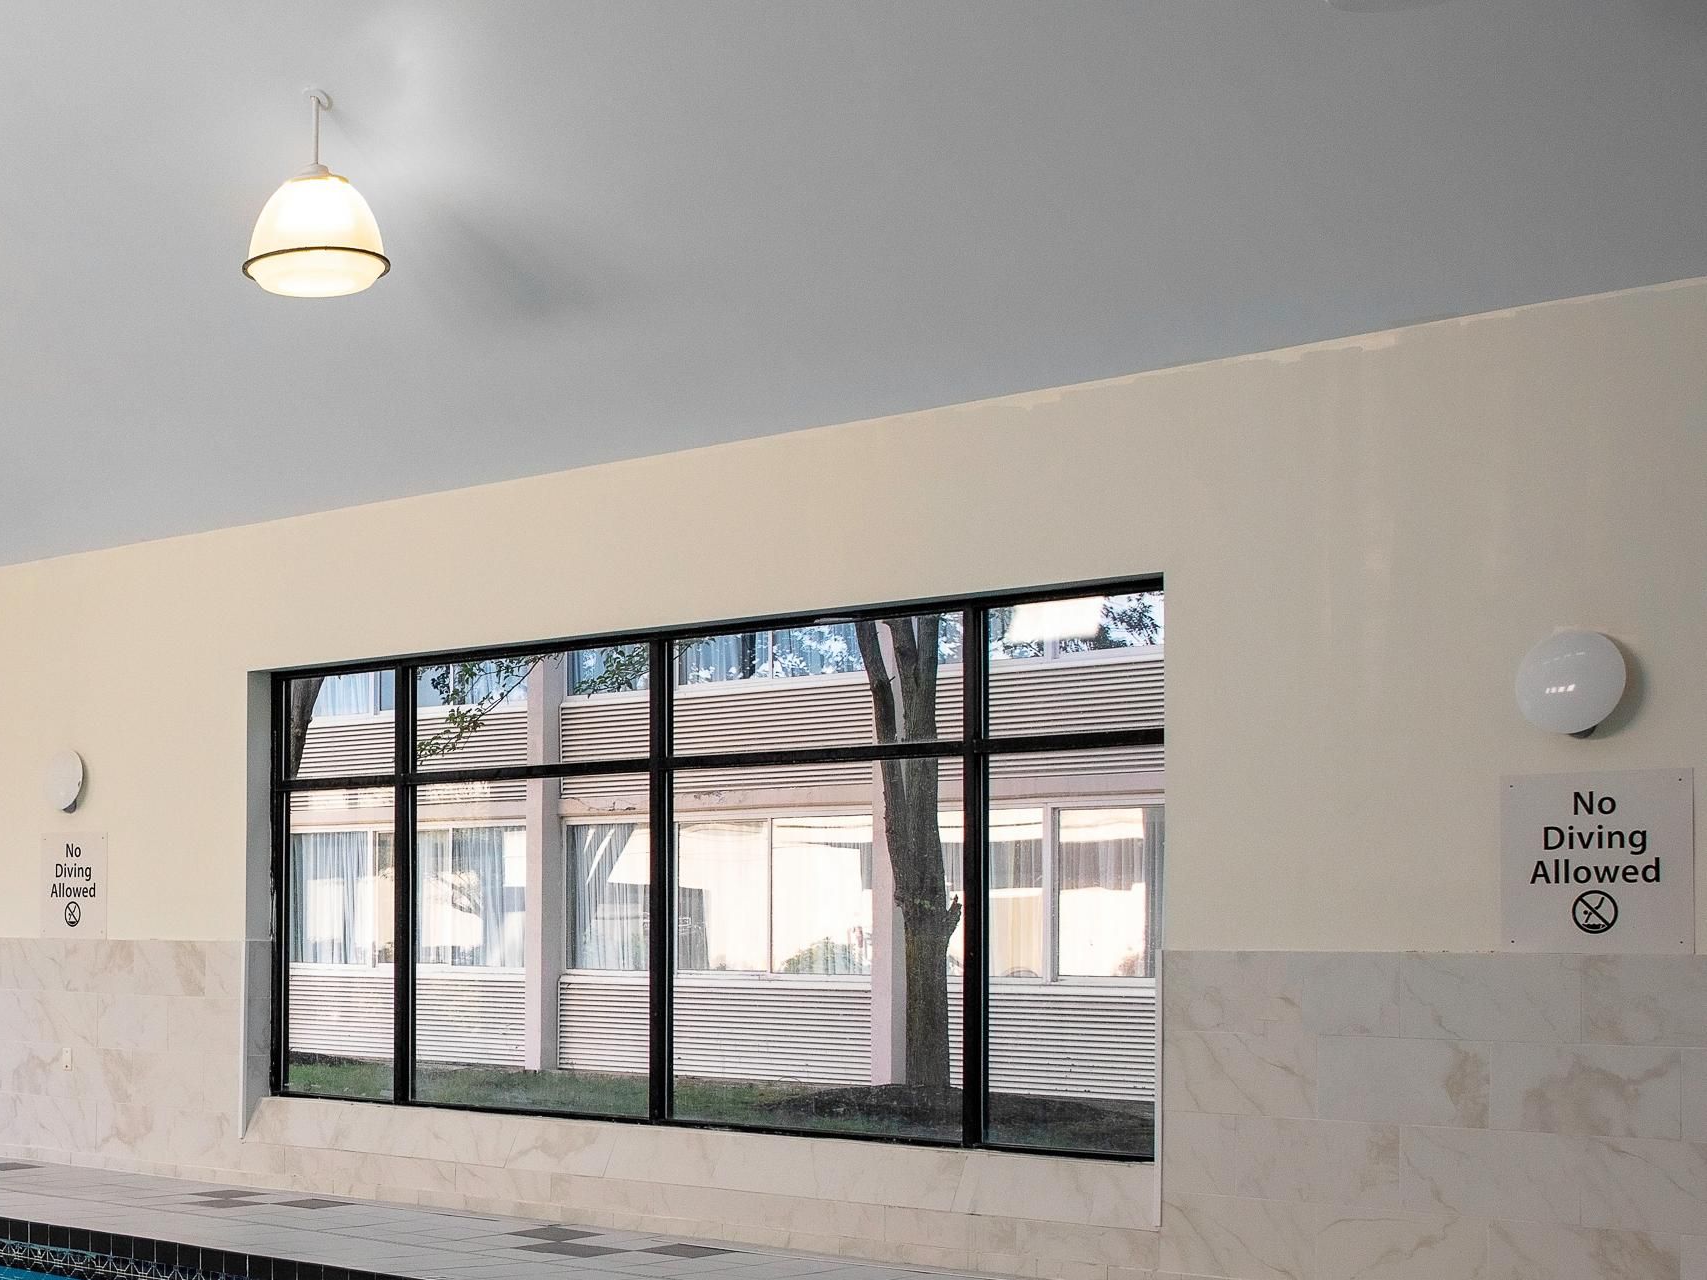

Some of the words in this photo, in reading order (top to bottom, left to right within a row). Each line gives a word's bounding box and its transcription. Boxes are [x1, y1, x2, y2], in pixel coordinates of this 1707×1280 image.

[1573, 791, 1616, 815] No
[1544, 824, 1647, 855] Diving
[65, 843, 82, 858] No
[55, 863, 92, 881] Diving
[1530, 857, 1661, 884] Allowed
[50, 882, 96, 898] Allowed
